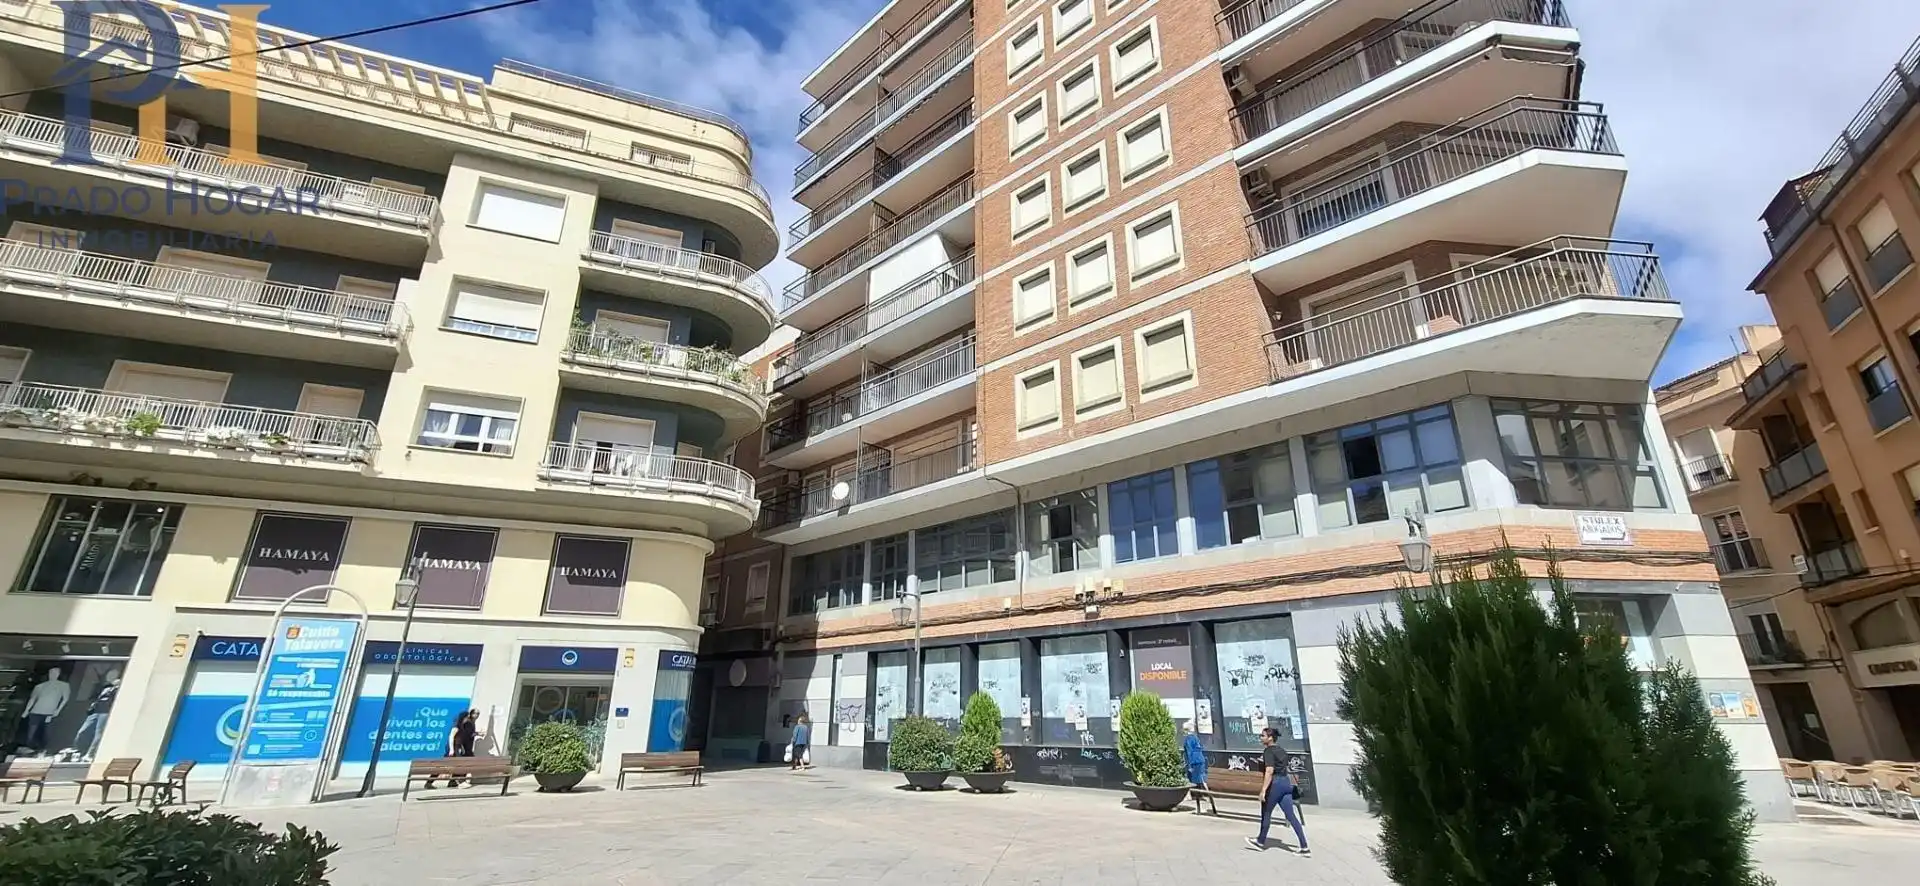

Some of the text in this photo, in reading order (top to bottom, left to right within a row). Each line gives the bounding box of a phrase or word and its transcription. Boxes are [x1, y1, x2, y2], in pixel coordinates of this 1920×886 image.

[259, 547, 330, 562] HAMAYA
[560, 566, 617, 579] HAMAYA
[1151, 662, 1173, 671] LOCAL
[1140, 670, 1187, 681] DISPONIBLE
[415, 706, 449, 718] ¡Que
[426, 718, 446, 729] los
[368, 729, 444, 740] dentes en
[372, 741, 441, 752] alavera!
